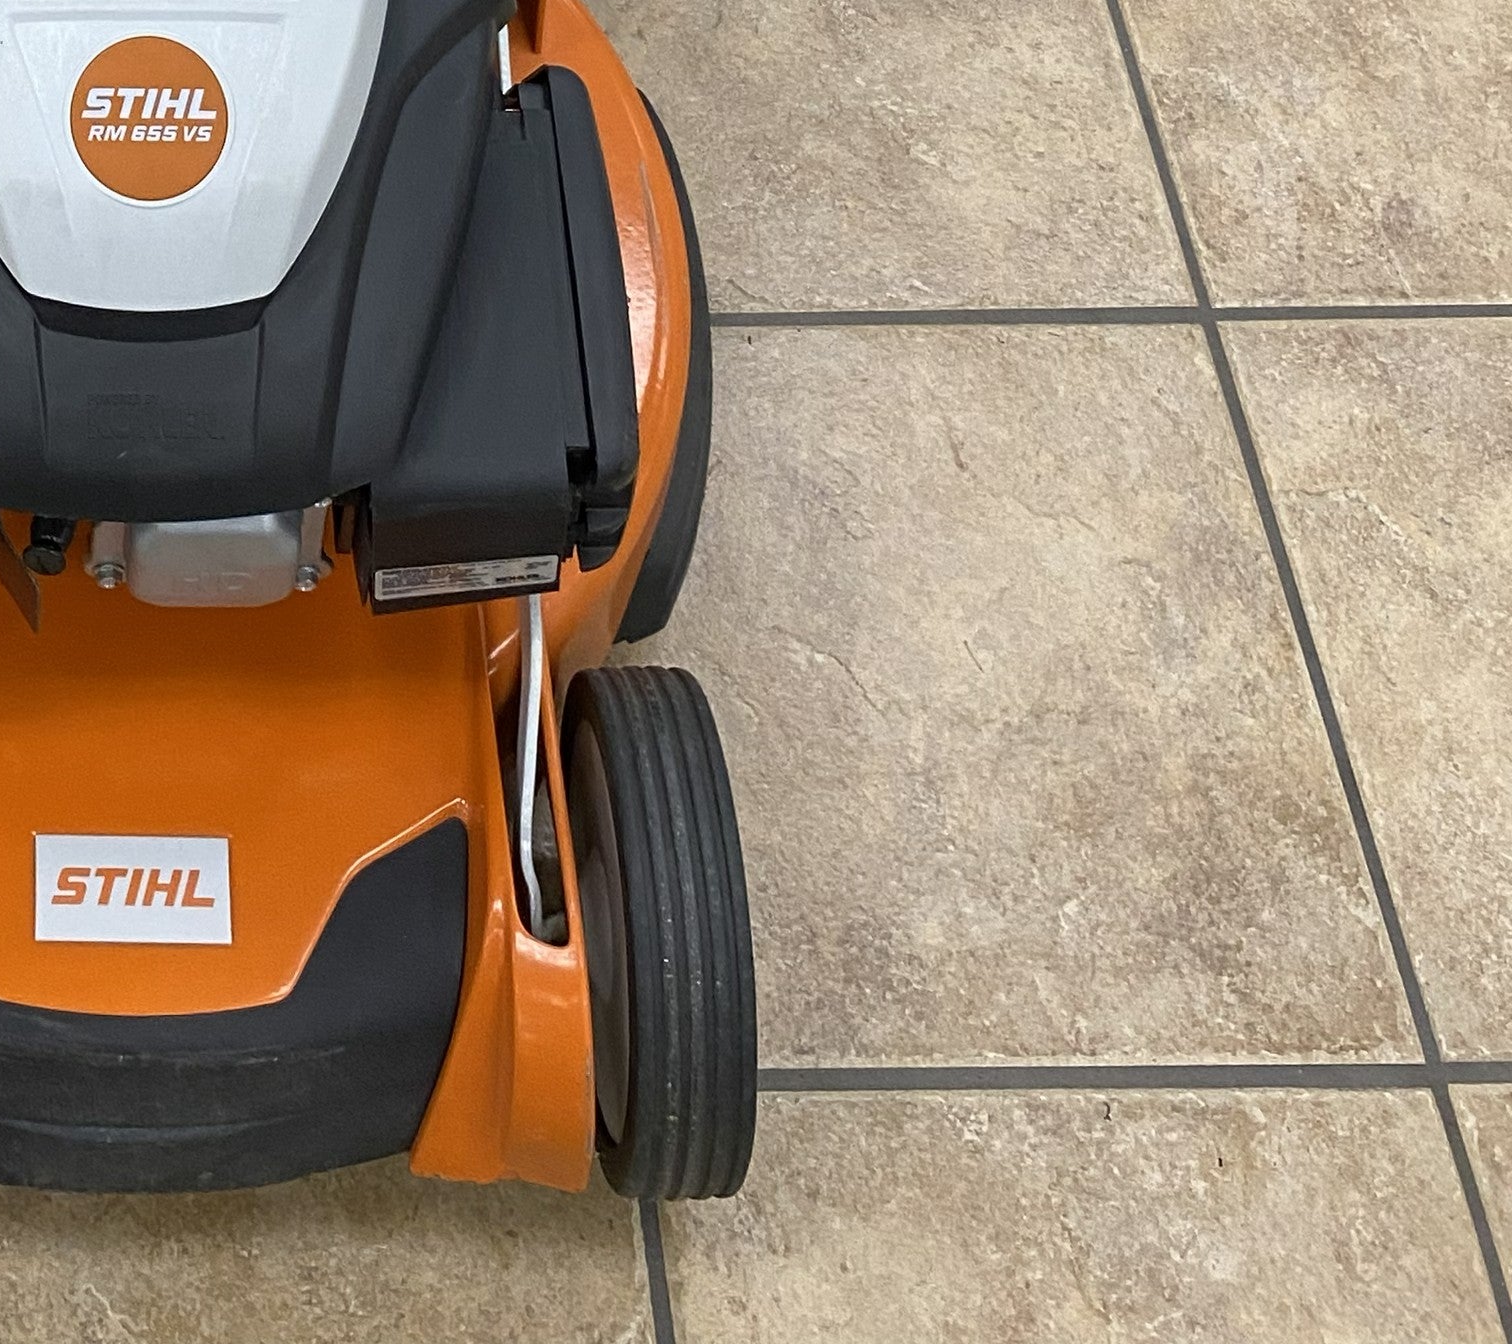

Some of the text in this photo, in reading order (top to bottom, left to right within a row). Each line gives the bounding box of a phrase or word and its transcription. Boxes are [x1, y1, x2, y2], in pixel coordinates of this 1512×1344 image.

[82, 88, 216, 119] STIHL
[88, 125, 212, 141] RM 655 VS
[51, 867, 216, 907] STIHL
